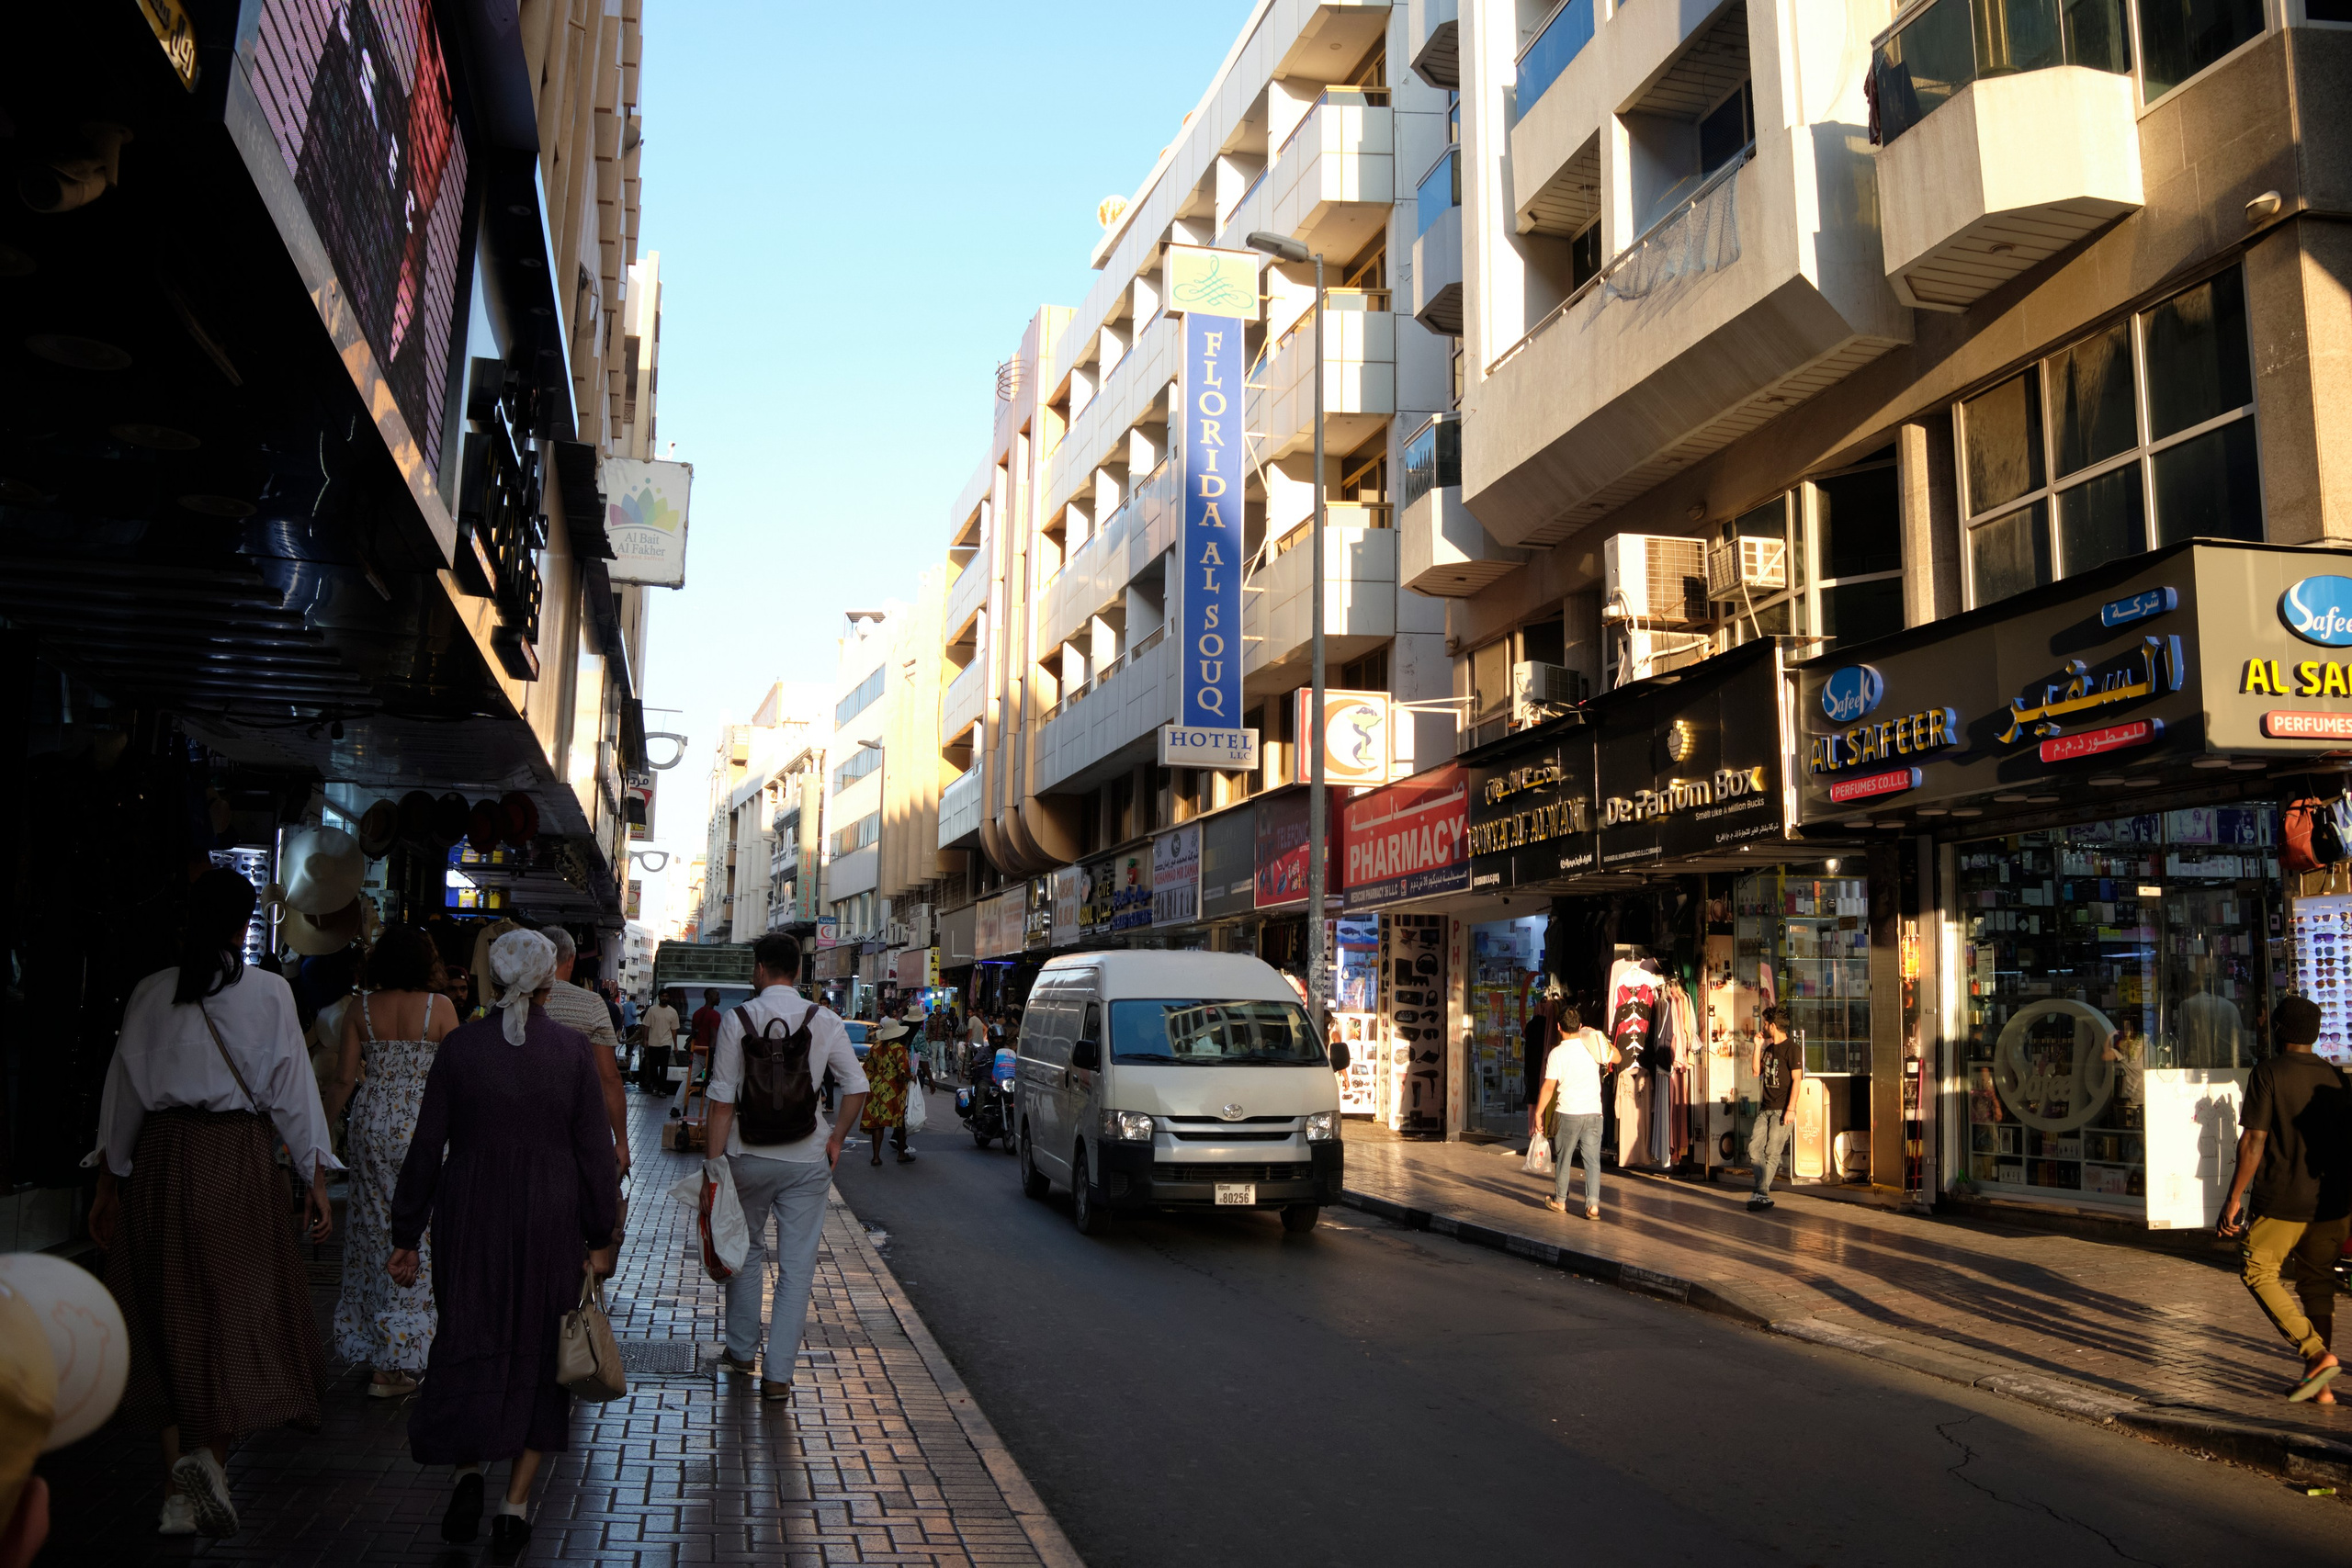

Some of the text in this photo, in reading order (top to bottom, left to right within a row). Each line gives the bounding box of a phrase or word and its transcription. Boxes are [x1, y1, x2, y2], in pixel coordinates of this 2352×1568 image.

[625, 533, 660, 545] Al Bait
[1197, 332, 1227, 717] FLORIDA AL SOUQ
[616, 543, 666, 557] Al Fakher
[2111, 592, 2159, 619] شركة
[1995, 635, 2183, 743] السفير
[2243, 658, 2290, 694] AL
[1170, 732, 1252, 752] HOTEL
[1810, 707, 1953, 773] AL SAFEER
[2086, 722, 2147, 752] للعطور
[1229, 751, 1251, 761] LLC
[1607, 766, 1762, 826] De Parfum Box
[1835, 778, 1876, 797] PERFUMES
[1351, 781, 1464, 836] صيدلية
[1747, 796, 1765, 810] Bucks
[1467, 818, 1510, 858] DUNYA
[1531, 797, 1585, 842] ALWAN
[1350, 814, 1464, 883] PHARMACY
[1365, 886, 1384, 901] PHARMACY
[1452, 919, 1461, 1123] PHARMACY
[1223, 1192, 1249, 1203] 80256
